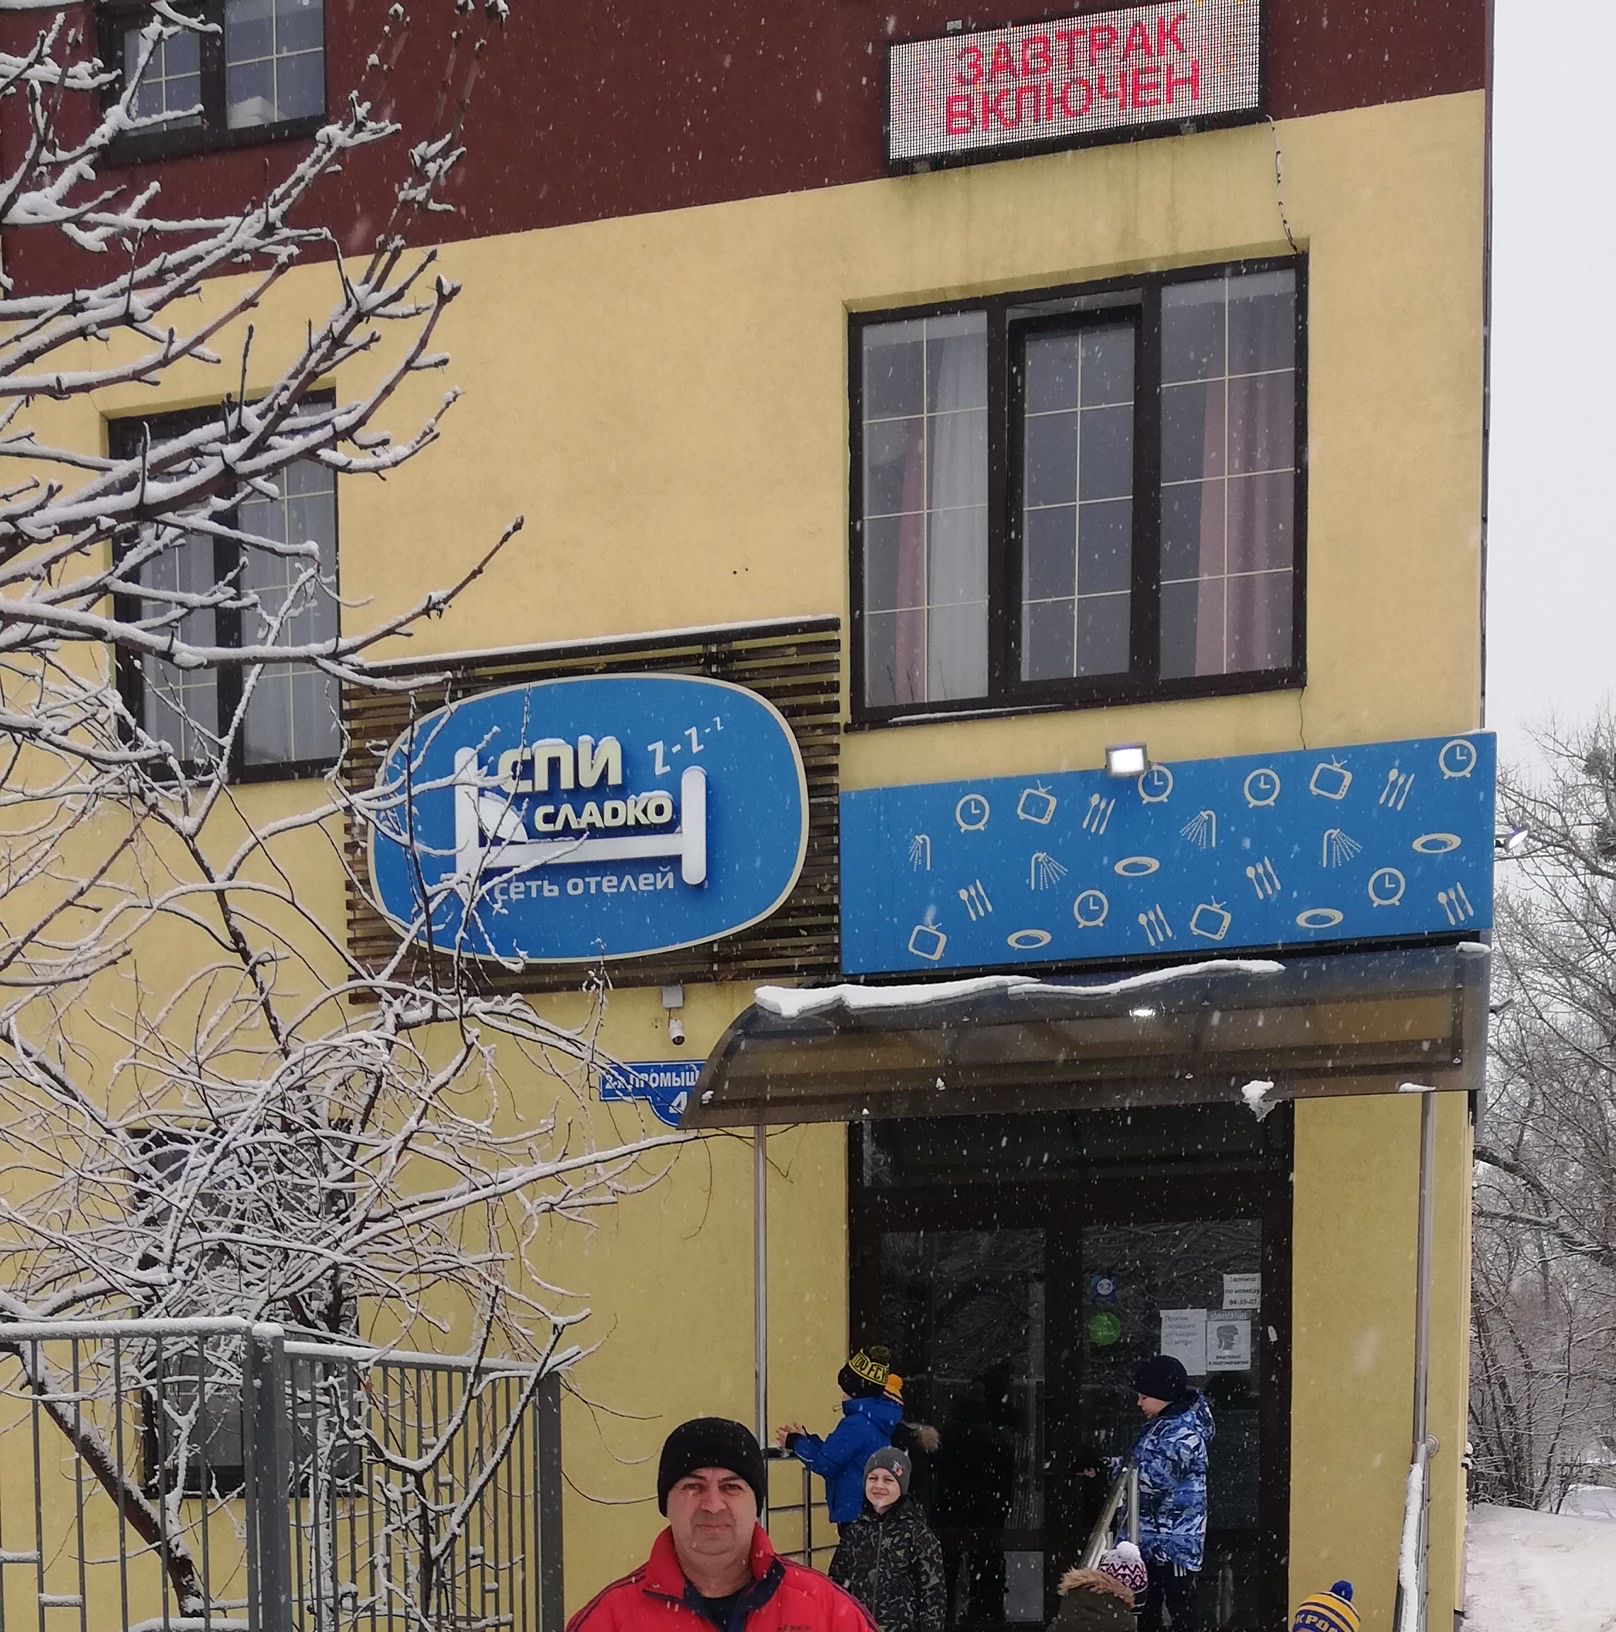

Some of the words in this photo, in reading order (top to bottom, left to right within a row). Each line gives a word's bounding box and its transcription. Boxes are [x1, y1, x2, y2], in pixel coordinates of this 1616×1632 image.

[956, 13, 1187, 87] ЗАВТРАК
[945, 59, 1201, 136] ВКЛЮЧЕН
[498, 738, 622, 793] СПИ
[534, 797, 673, 832] СЛАДКО
[494, 879, 559, 901] сеть
[566, 866, 674, 896] отелей
